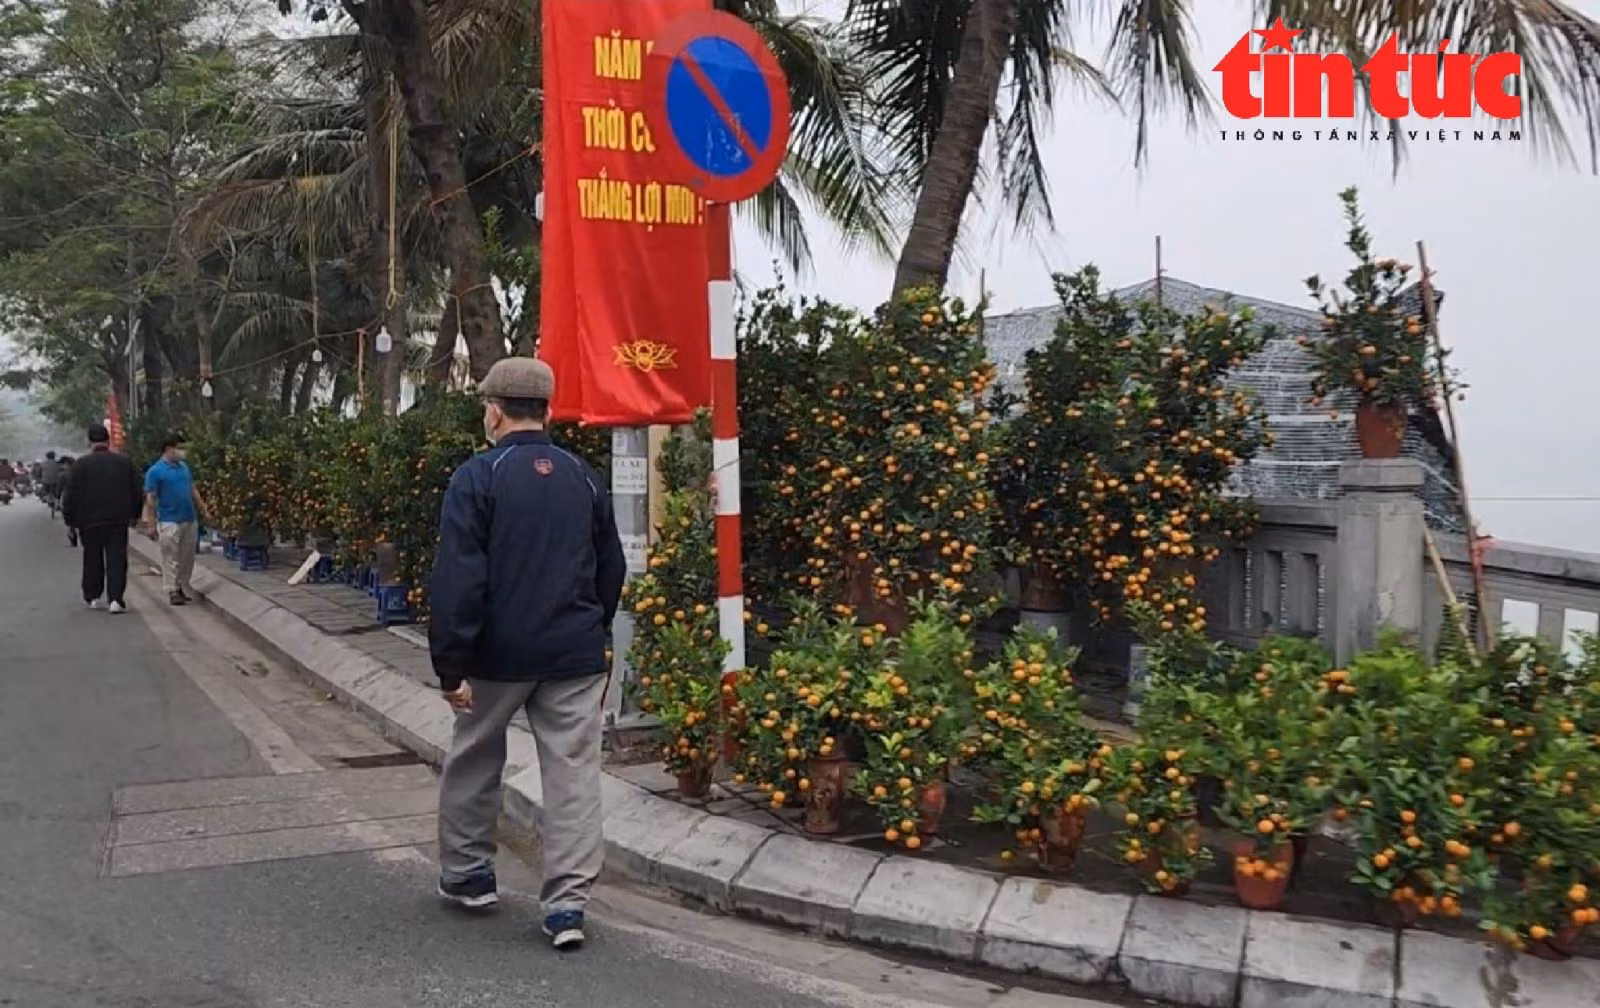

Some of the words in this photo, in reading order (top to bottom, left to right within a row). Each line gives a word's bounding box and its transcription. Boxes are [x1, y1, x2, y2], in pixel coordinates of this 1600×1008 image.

[595, 29, 641, 80] NĂM
[582, 98, 625, 151] THỜI
[577, 166, 632, 221] THẮNG
[635, 180, 661, 232] LỢI
